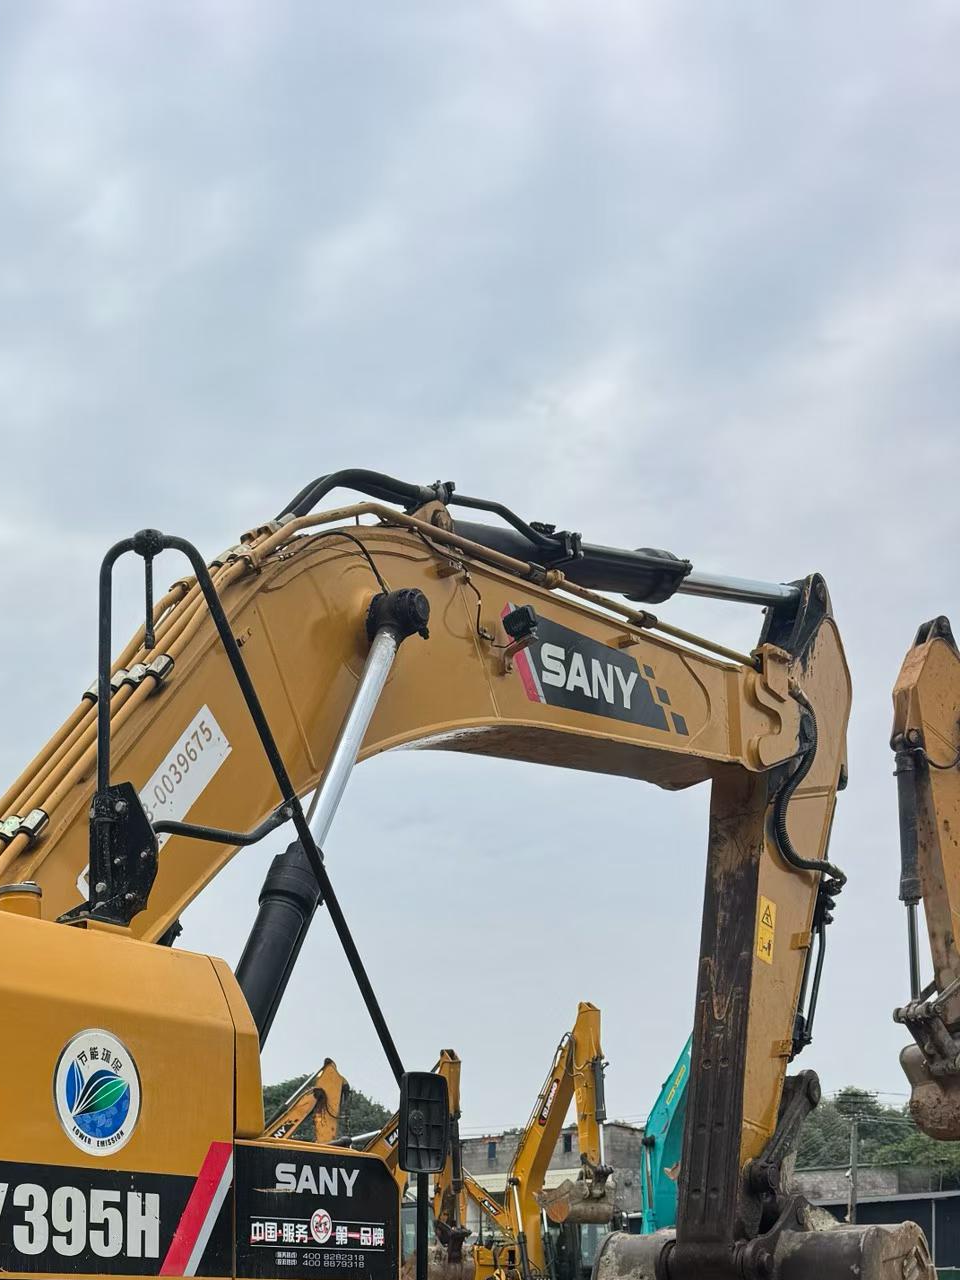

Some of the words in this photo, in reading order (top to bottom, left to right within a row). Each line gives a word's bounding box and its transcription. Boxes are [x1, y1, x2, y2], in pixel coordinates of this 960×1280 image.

[540, 642, 639, 710] SANY
[77, 1046, 123, 1073] 节能环保
[72, 1125, 92, 1145] LOWER
[96, 1129, 125, 1147] EMISSION
[275, 1162, 360, 1197] SANY
[335, 1226, 385, 1247] 第一品牌
[302, 1252, 320, 1260] 400
